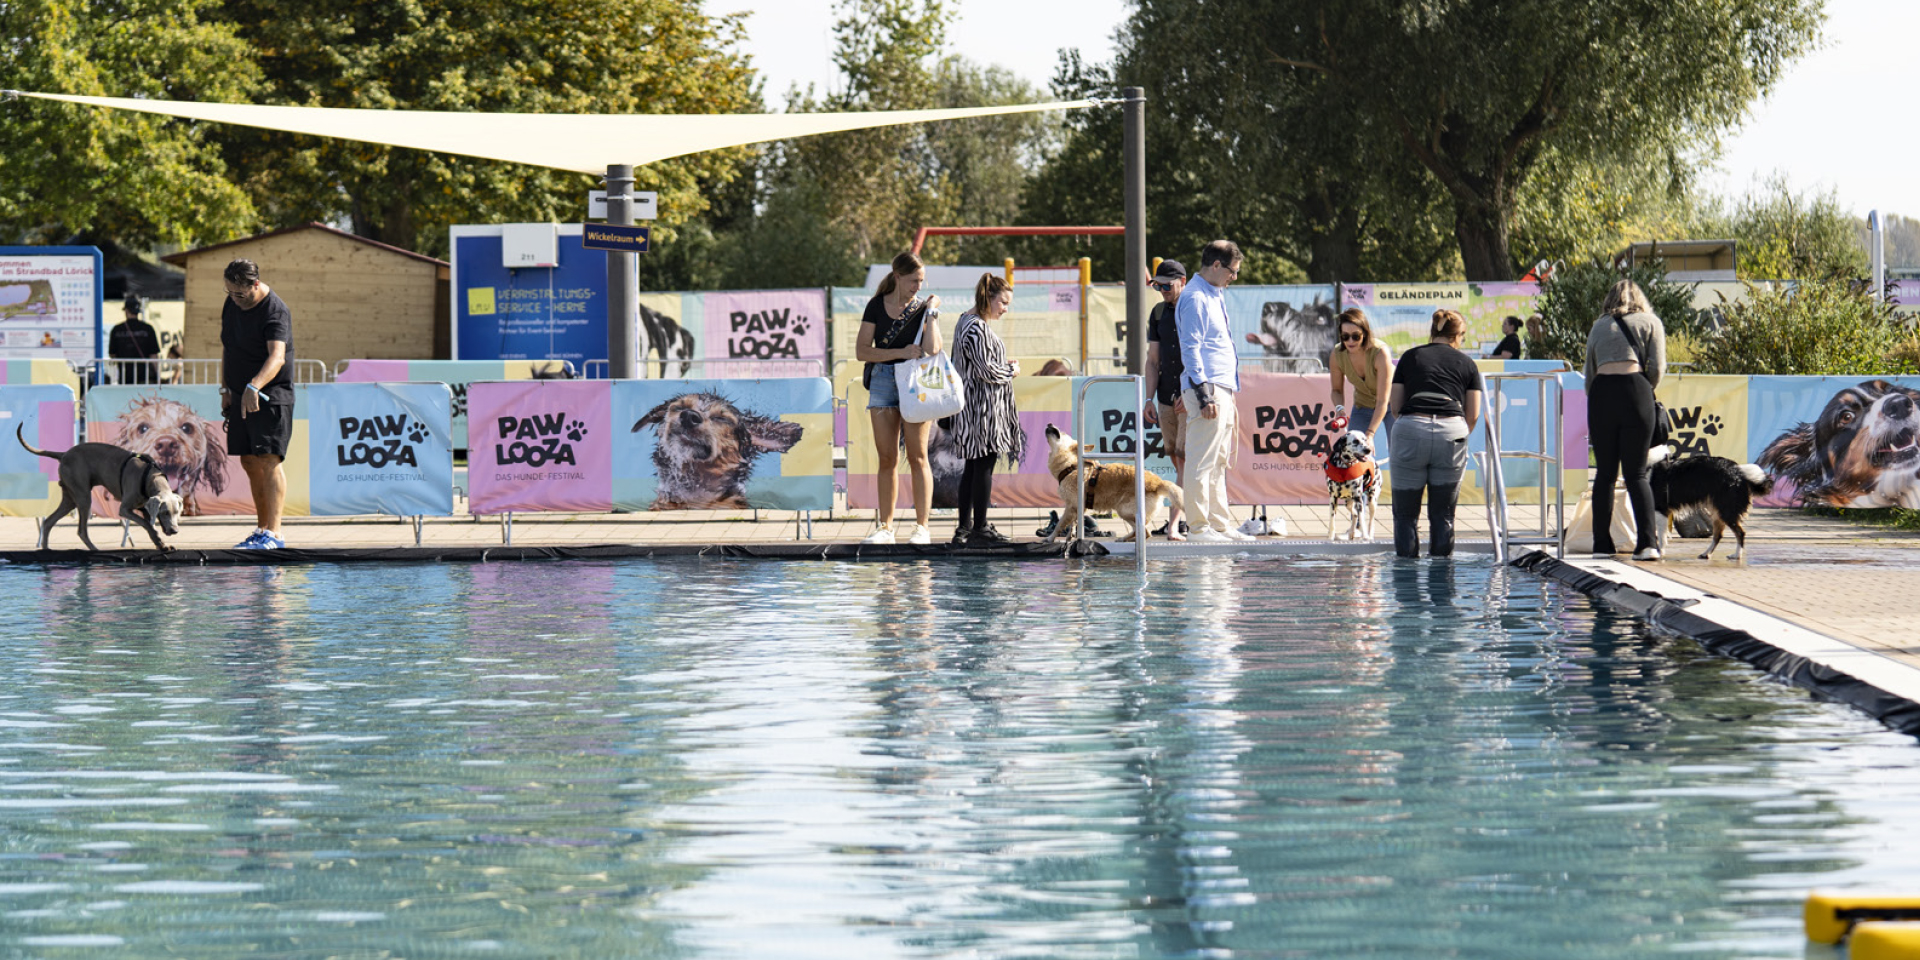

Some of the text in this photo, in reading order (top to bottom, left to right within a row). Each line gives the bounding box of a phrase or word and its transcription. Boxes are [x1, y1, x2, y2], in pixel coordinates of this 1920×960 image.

[587, 231, 634, 243] Wickelraum
[16, 267, 63, 275] Strandbad
[498, 301, 542, 313] SERVICE
[553, 301, 586, 313] HERNE
[1379, 289, 1463, 299] GELÄNDEPLAN
[730, 308, 791, 334] PAW
[728, 333, 800, 360] LOOZA
[339, 414, 407, 440] PAW
[498, 412, 565, 440] PAW
[1255, 403, 1323, 430] PAW
[337, 440, 417, 468] LOOZA
[496, 438, 576, 467] LOOZA
[1253, 429, 1332, 458] LOOZA
[1667, 431, 1711, 458] OZA
[337, 473, 426, 482] DAS HUNDE-FESTIVAL
[495, 472, 585, 481] DAS HUNDE-FESTIVAL
[1252, 462, 1325, 471] DAS HUNDE-FEST
